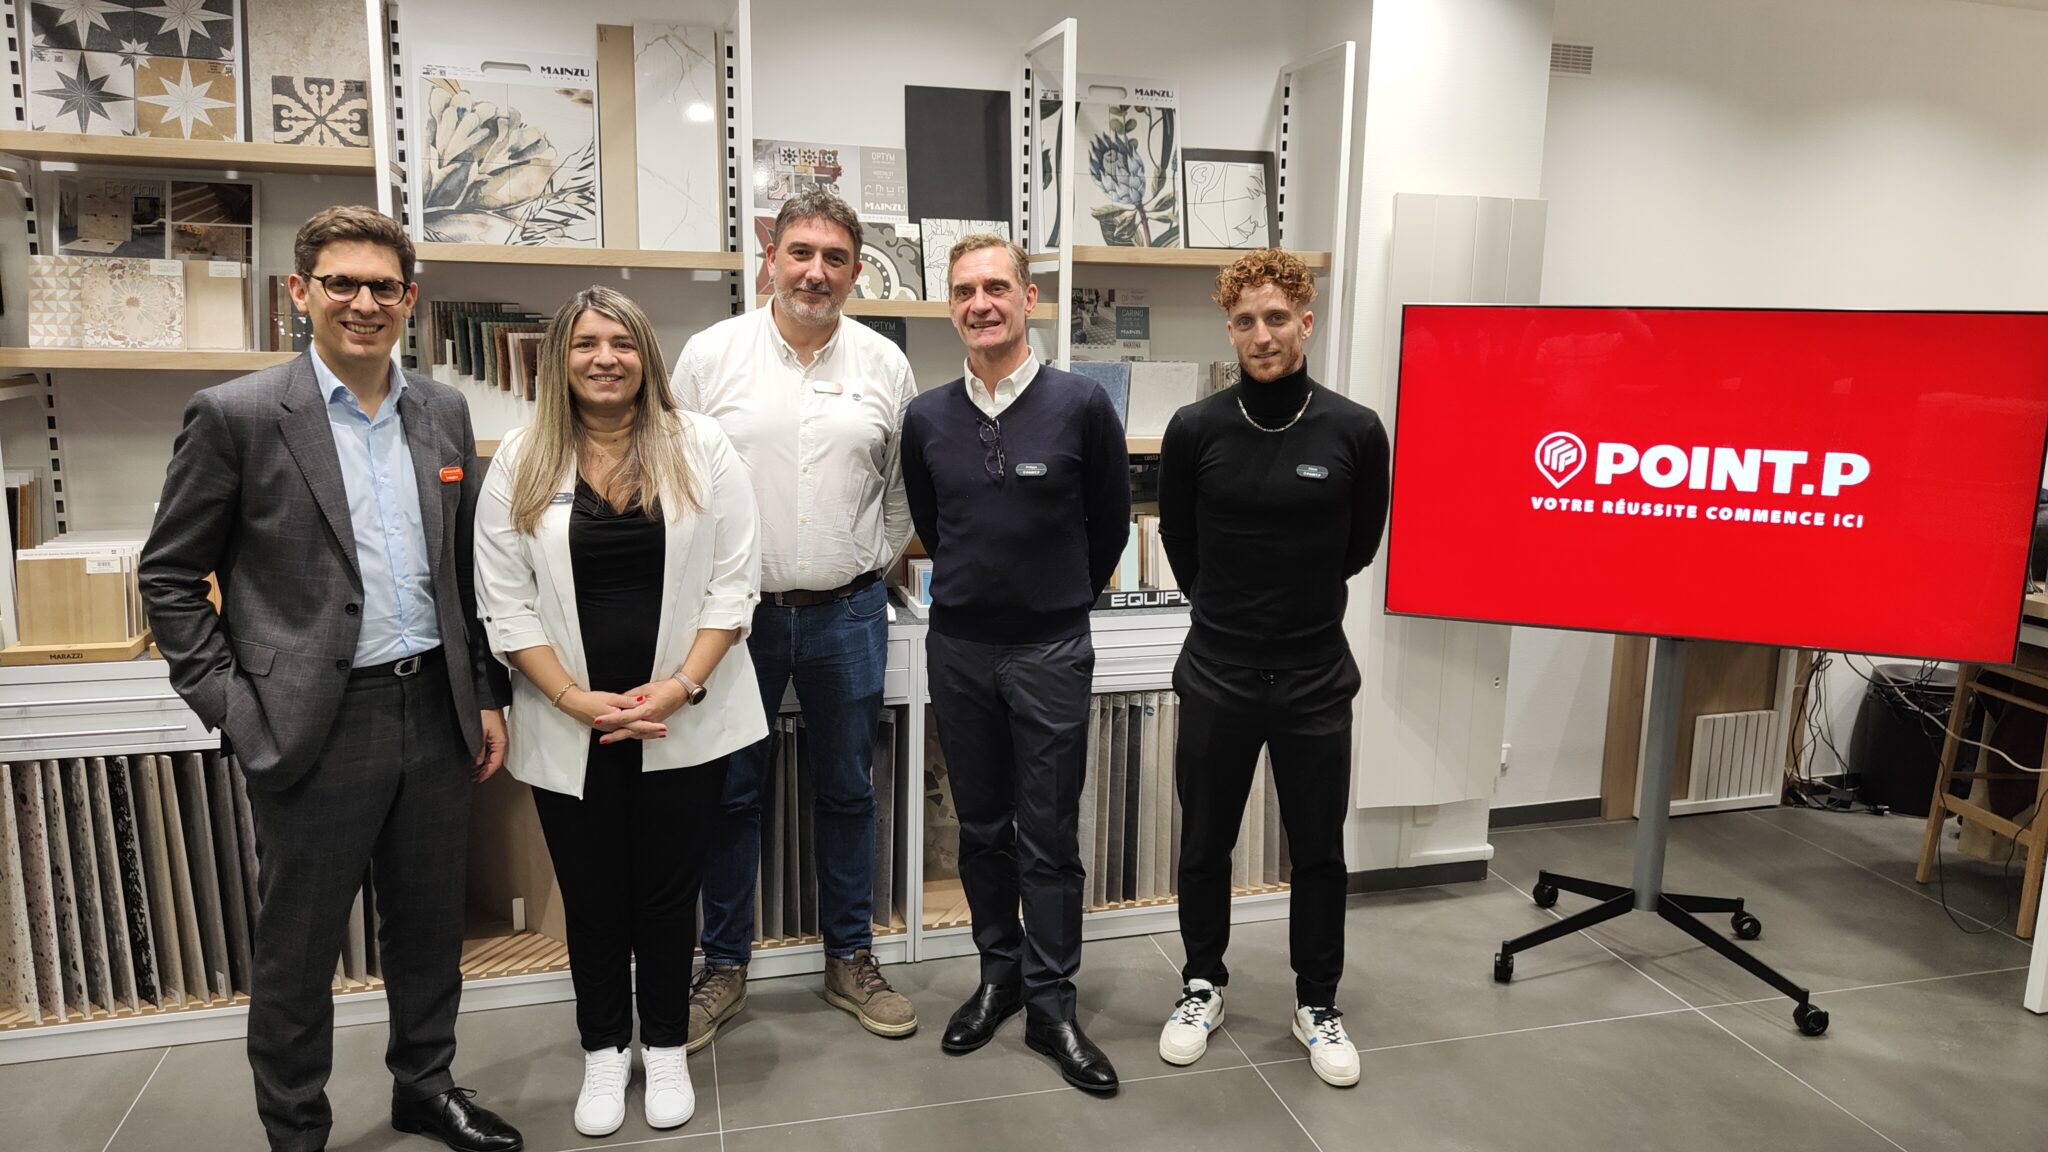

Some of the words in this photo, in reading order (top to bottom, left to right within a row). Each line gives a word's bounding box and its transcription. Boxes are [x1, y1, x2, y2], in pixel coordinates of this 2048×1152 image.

[540, 65, 590, 78] MAINZU
[1134, 87, 1174, 98] MAINZU
[871, 151, 896, 162] OPTYM
[864, 201, 906, 212] MAINZU
[1595, 441, 1871, 497] POINT.P
[1531, 496, 1595, 513] VOTRE
[1601, 498, 1698, 519] RÉUSSITE
[1705, 505, 1826, 527] COMMENCE
[1832, 513, 1864, 529] ICI
[49, 652, 84, 661] MARAZZI
